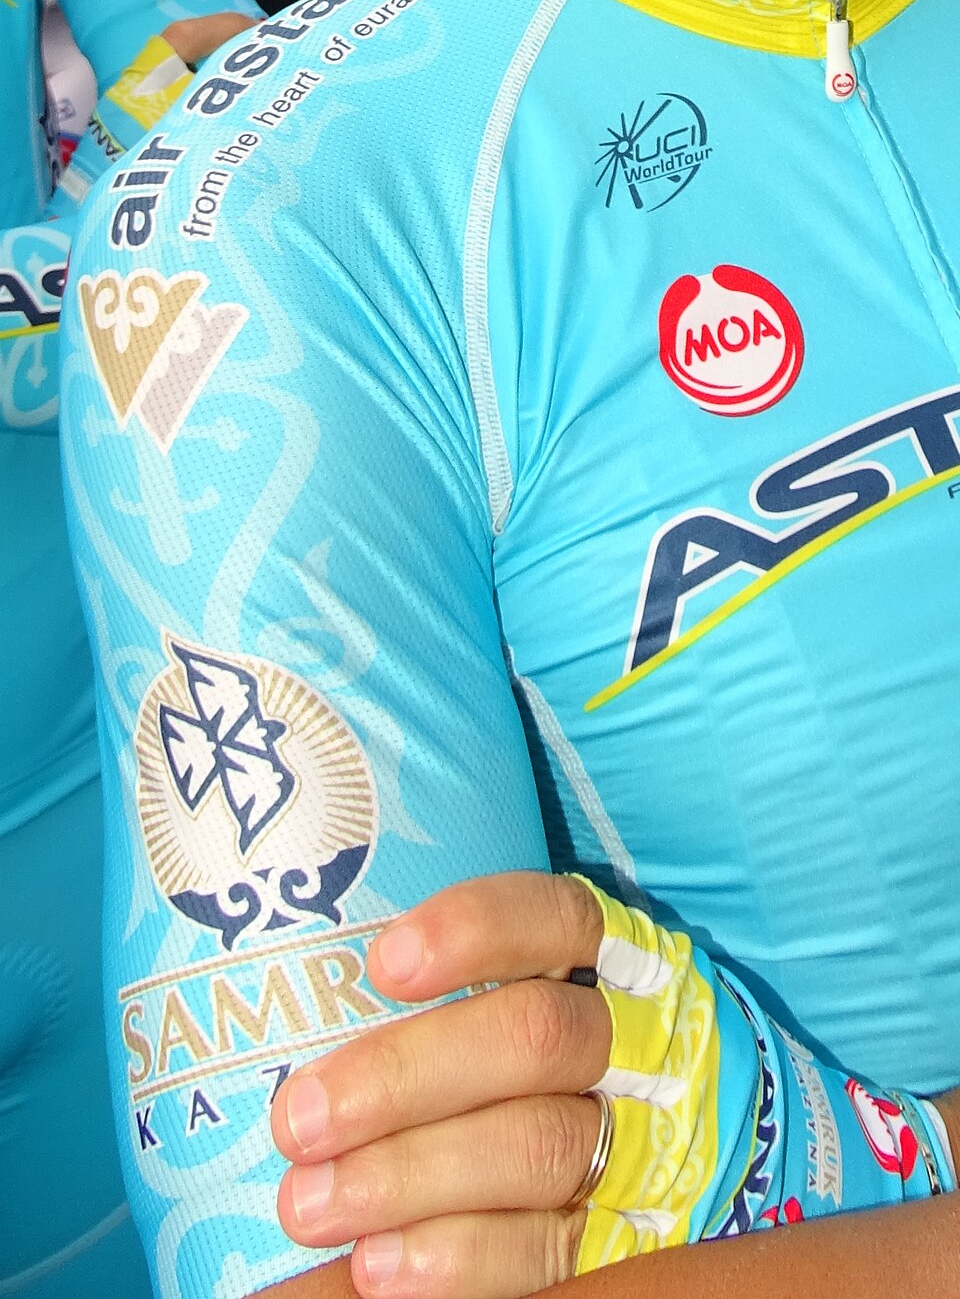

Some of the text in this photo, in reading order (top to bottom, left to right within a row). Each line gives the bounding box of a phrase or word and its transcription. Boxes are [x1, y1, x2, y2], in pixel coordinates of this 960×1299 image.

[183, 168, 229, 237] from
[225, 132, 259, 170] the
[252, 69, 320, 127] heart
[325, 36, 355, 64] of
[624, 147, 713, 183] WorldTour
[635, 124, 696, 163] UCI
[112, 135, 184, 246] air
[684, 308, 783, 367] MOA
[121, 949, 388, 1082] SAMR
